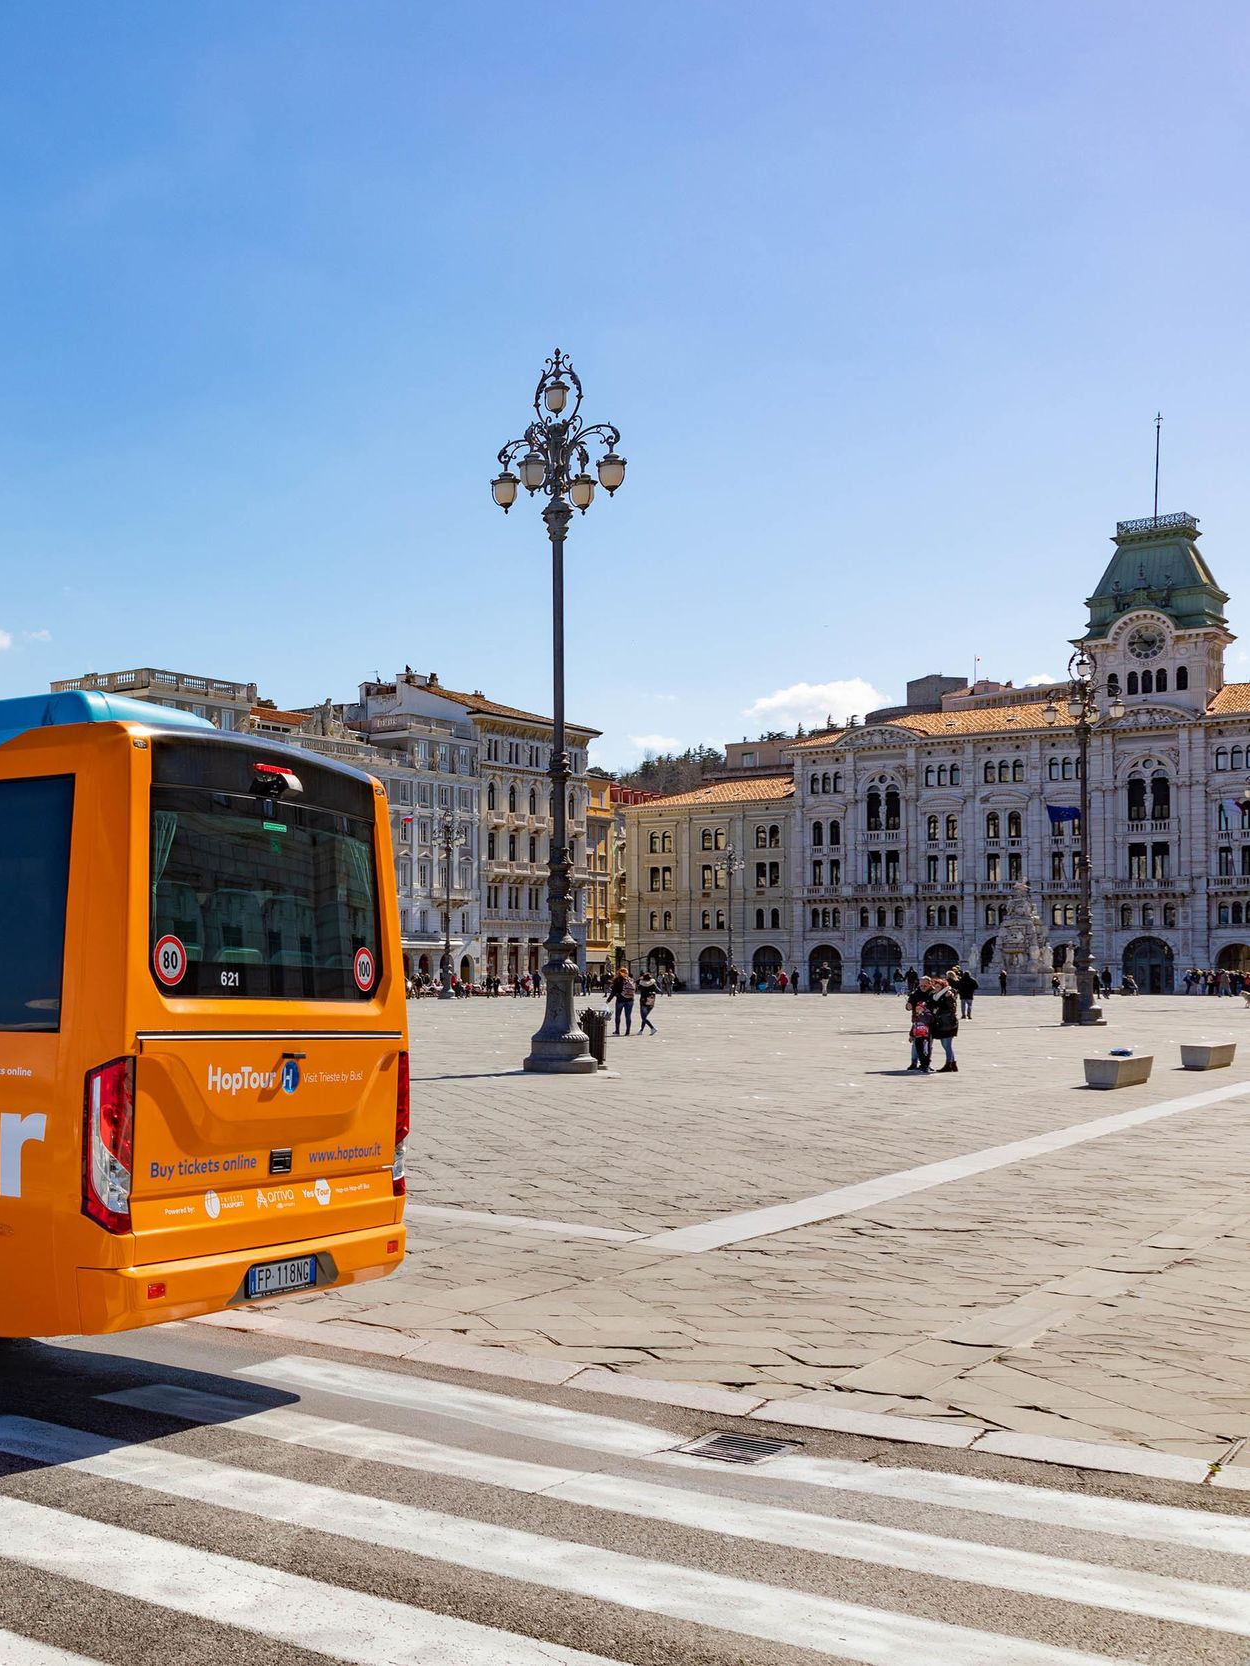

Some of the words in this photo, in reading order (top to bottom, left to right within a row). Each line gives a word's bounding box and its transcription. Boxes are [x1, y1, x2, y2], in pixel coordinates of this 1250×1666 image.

[163, 950, 178, 970] 80
[358, 960, 371, 977] 100
[220, 971, 240, 986] 621
[7, 1066, 32, 1077] online
[208, 1063, 277, 1096] HopTour
[303, 1072, 318, 1083] Visit
[319, 1071, 340, 1082] Trieste
[341, 1071, 349, 1083] by
[350, 1070, 363, 1081] Bus!
[308, 1143, 382, 1163] www.hoptour.it
[150, 1161, 174, 1181] Buy
[178, 1158, 220, 1176] tickets
[222, 1156, 257, 1172] online
[302, 1189, 315, 1199] Yes
[164, 1206, 187, 1215] Powered
[187, 1205, 196, 1215] by:
[277, 1260, 309, 1286] 118NG
